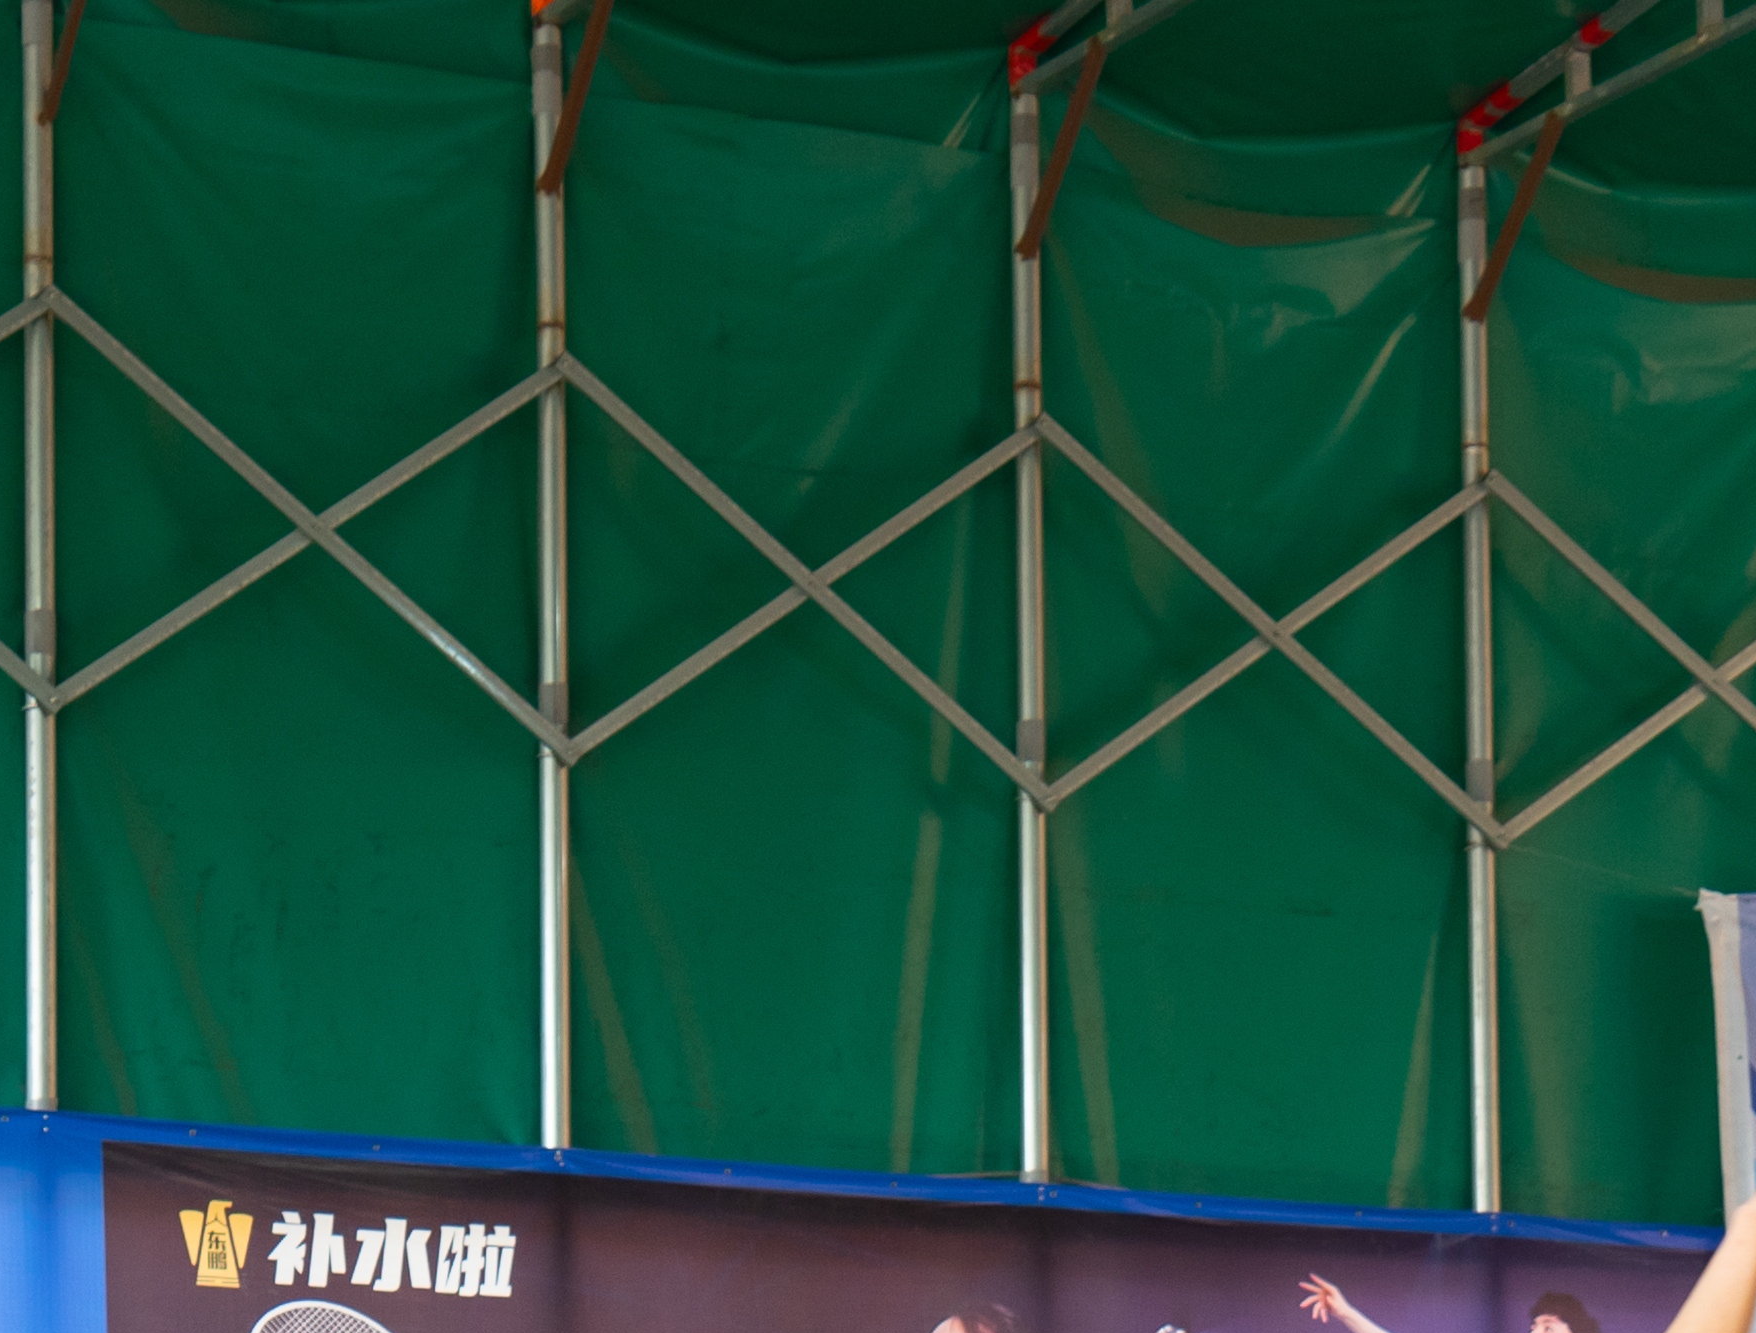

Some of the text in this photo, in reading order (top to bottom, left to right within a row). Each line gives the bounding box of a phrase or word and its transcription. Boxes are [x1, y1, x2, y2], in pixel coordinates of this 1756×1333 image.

[207, 1230, 228, 1270] 东鹏
[267, 1210, 517, 1298] 补水啦
